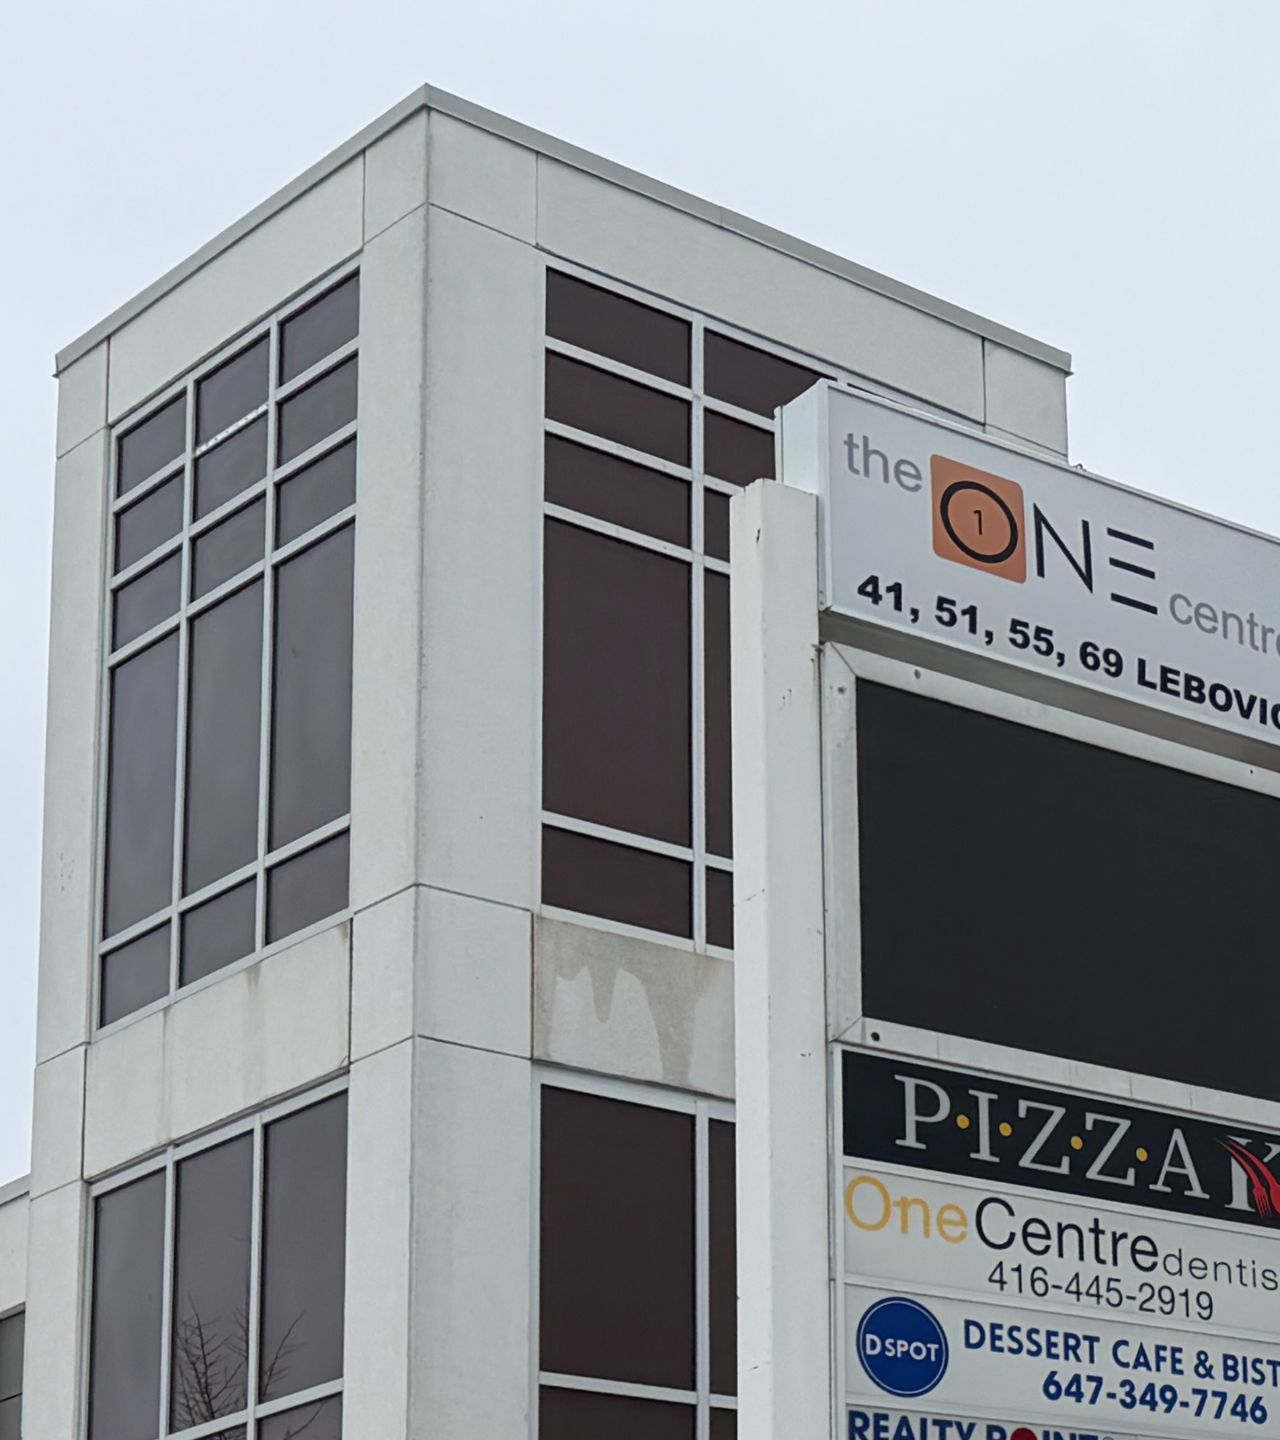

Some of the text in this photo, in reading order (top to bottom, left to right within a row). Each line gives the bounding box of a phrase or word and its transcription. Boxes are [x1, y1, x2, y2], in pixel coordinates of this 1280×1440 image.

[843, 433, 923, 492] the
[940, 480, 1158, 615] ONE
[857, 575, 920, 623] 41,
[935, 596, 994, 646] 51,
[1008, 618, 1065, 668] 55,
[1080, 641, 1123, 679] 69
[988, 1261, 1214, 1321] 416-445-2919
[964, 1319, 1101, 1364] DESSERT
[1112, 1339, 1185, 1376] CAFE
[1193, 1351, 1215, 1379] &
[1042, 1371, 1269, 1425] 647-349-7746
